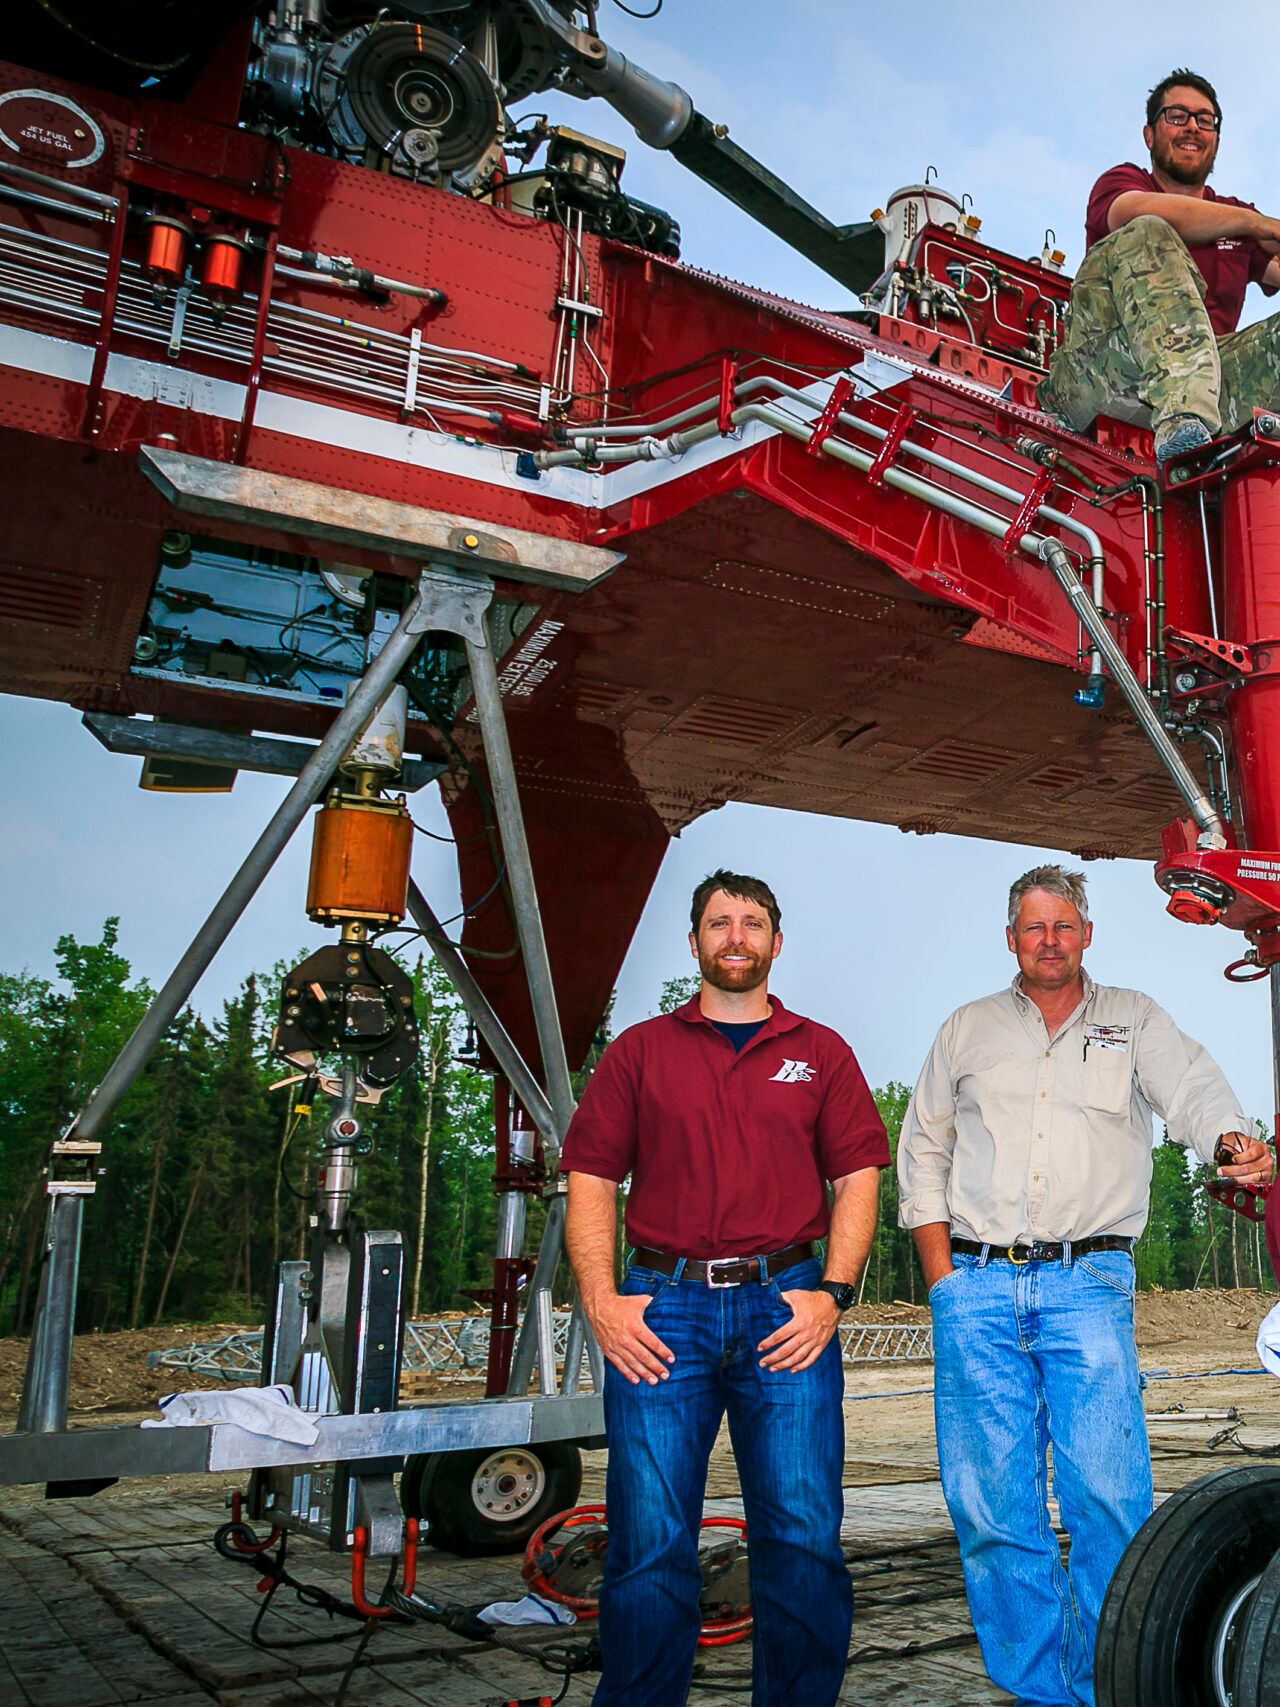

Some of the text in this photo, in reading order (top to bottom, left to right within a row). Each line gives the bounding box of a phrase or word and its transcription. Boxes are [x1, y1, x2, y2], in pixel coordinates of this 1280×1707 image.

[20, 129, 74, 151] 454 US GAL
[27, 125, 69, 143] JET FUEL
[514, 619, 565, 663] MAXIMUM
[1241, 858, 1270, 870] MAXIMUM
[1237, 869, 1267, 880] PRESSURE
[1268, 871, 1276, 881] 50
